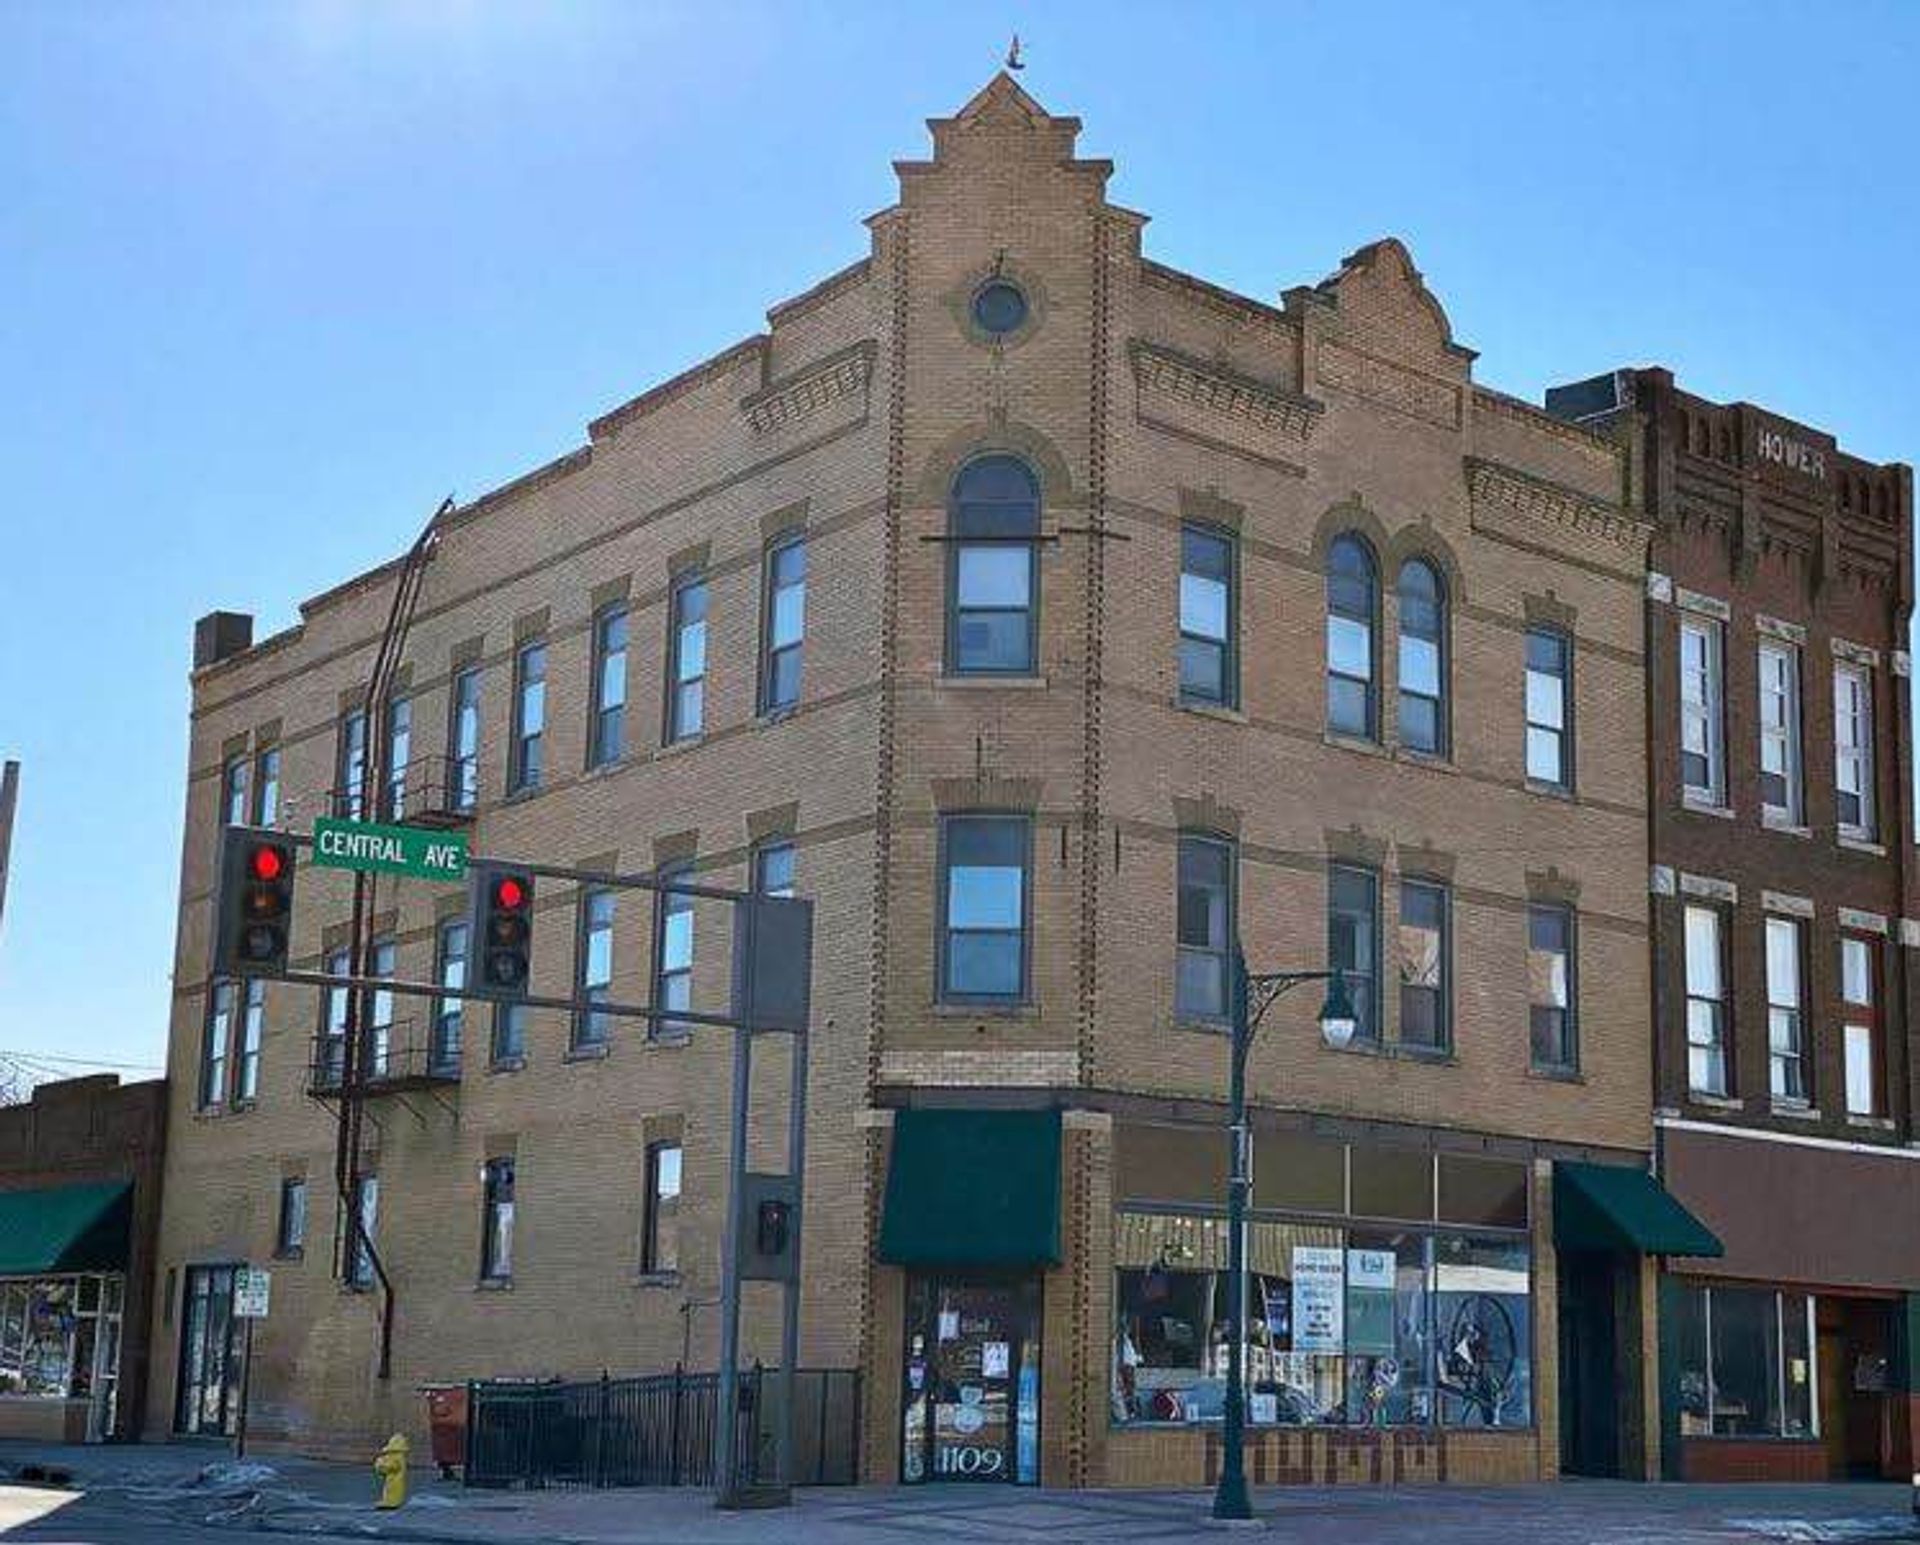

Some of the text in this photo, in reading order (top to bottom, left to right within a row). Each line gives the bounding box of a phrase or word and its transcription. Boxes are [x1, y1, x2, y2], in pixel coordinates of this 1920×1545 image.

[320, 830, 460, 870] CENTRAL AVE
[943, 1446, 1002, 1473] 1109
